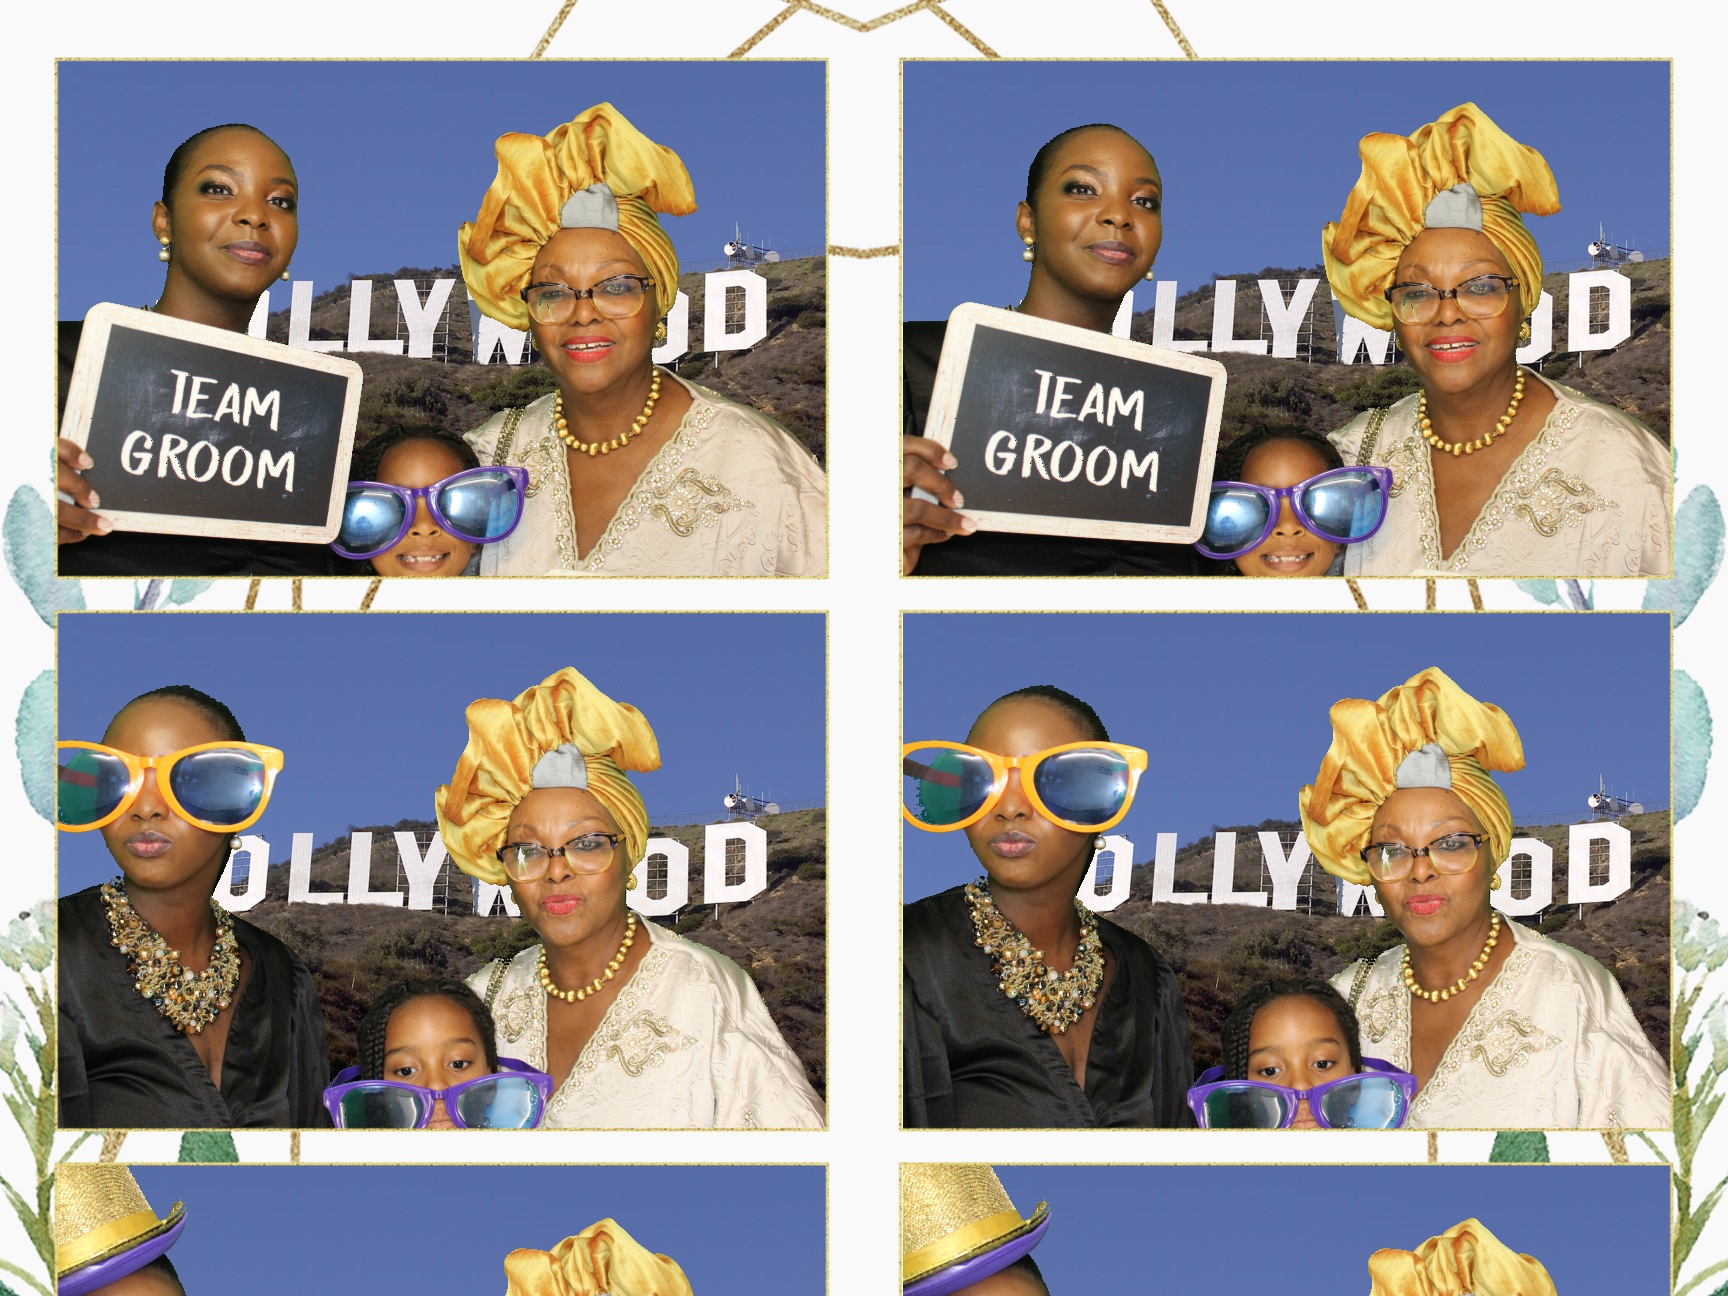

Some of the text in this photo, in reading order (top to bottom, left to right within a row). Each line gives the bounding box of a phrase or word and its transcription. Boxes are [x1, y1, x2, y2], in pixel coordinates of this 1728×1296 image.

[170, 369, 281, 432] TEAM
[1034, 369, 1145, 432] TEAM
[121, 430, 295, 493] GROOM
[985, 430, 1159, 493] GROOM
